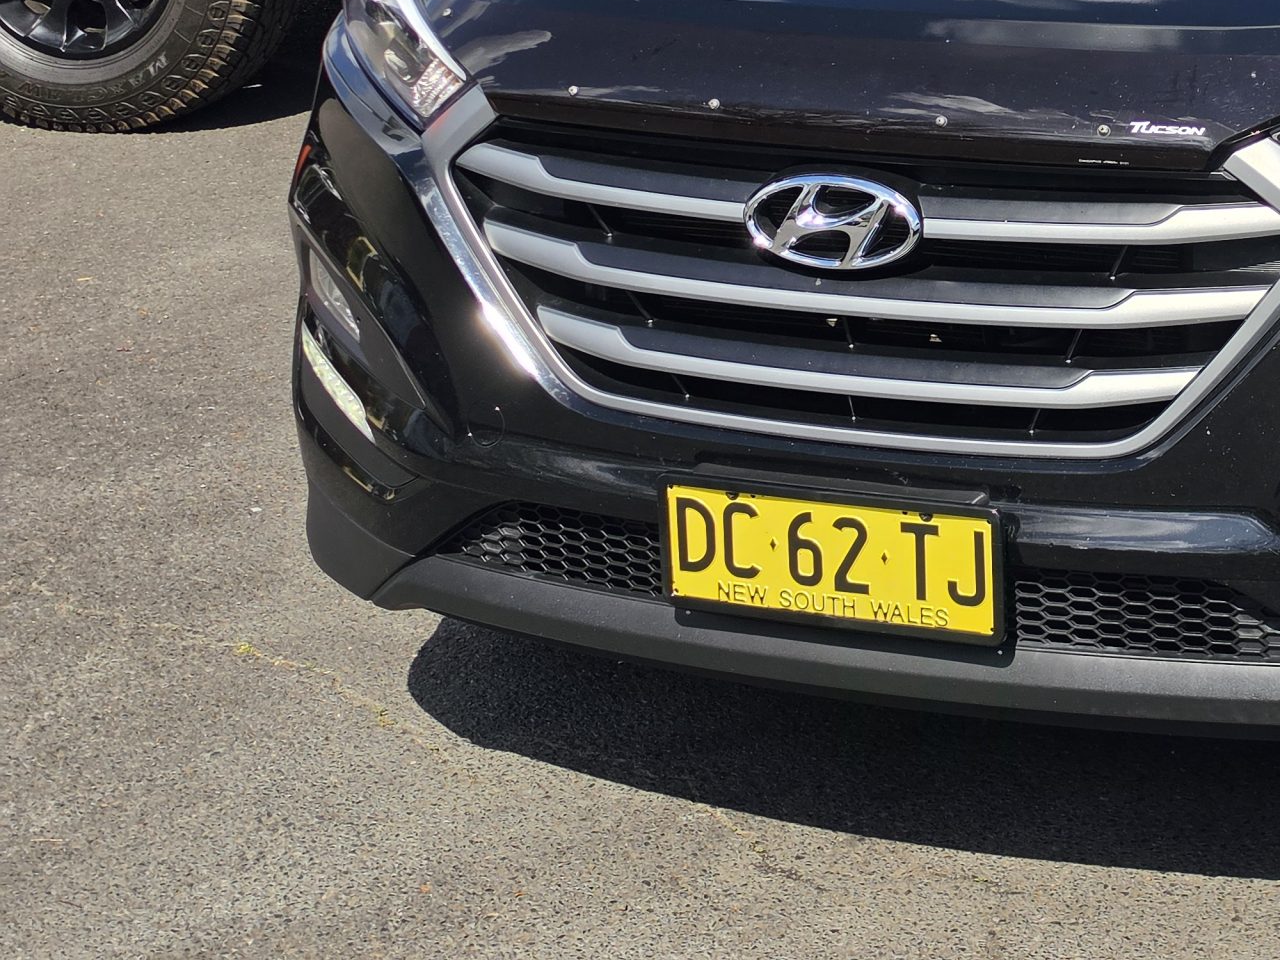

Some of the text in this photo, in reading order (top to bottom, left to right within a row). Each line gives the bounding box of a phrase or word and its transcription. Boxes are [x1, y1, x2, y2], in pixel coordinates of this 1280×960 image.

[717, 580, 950, 628] NEW SOUTH WALES
